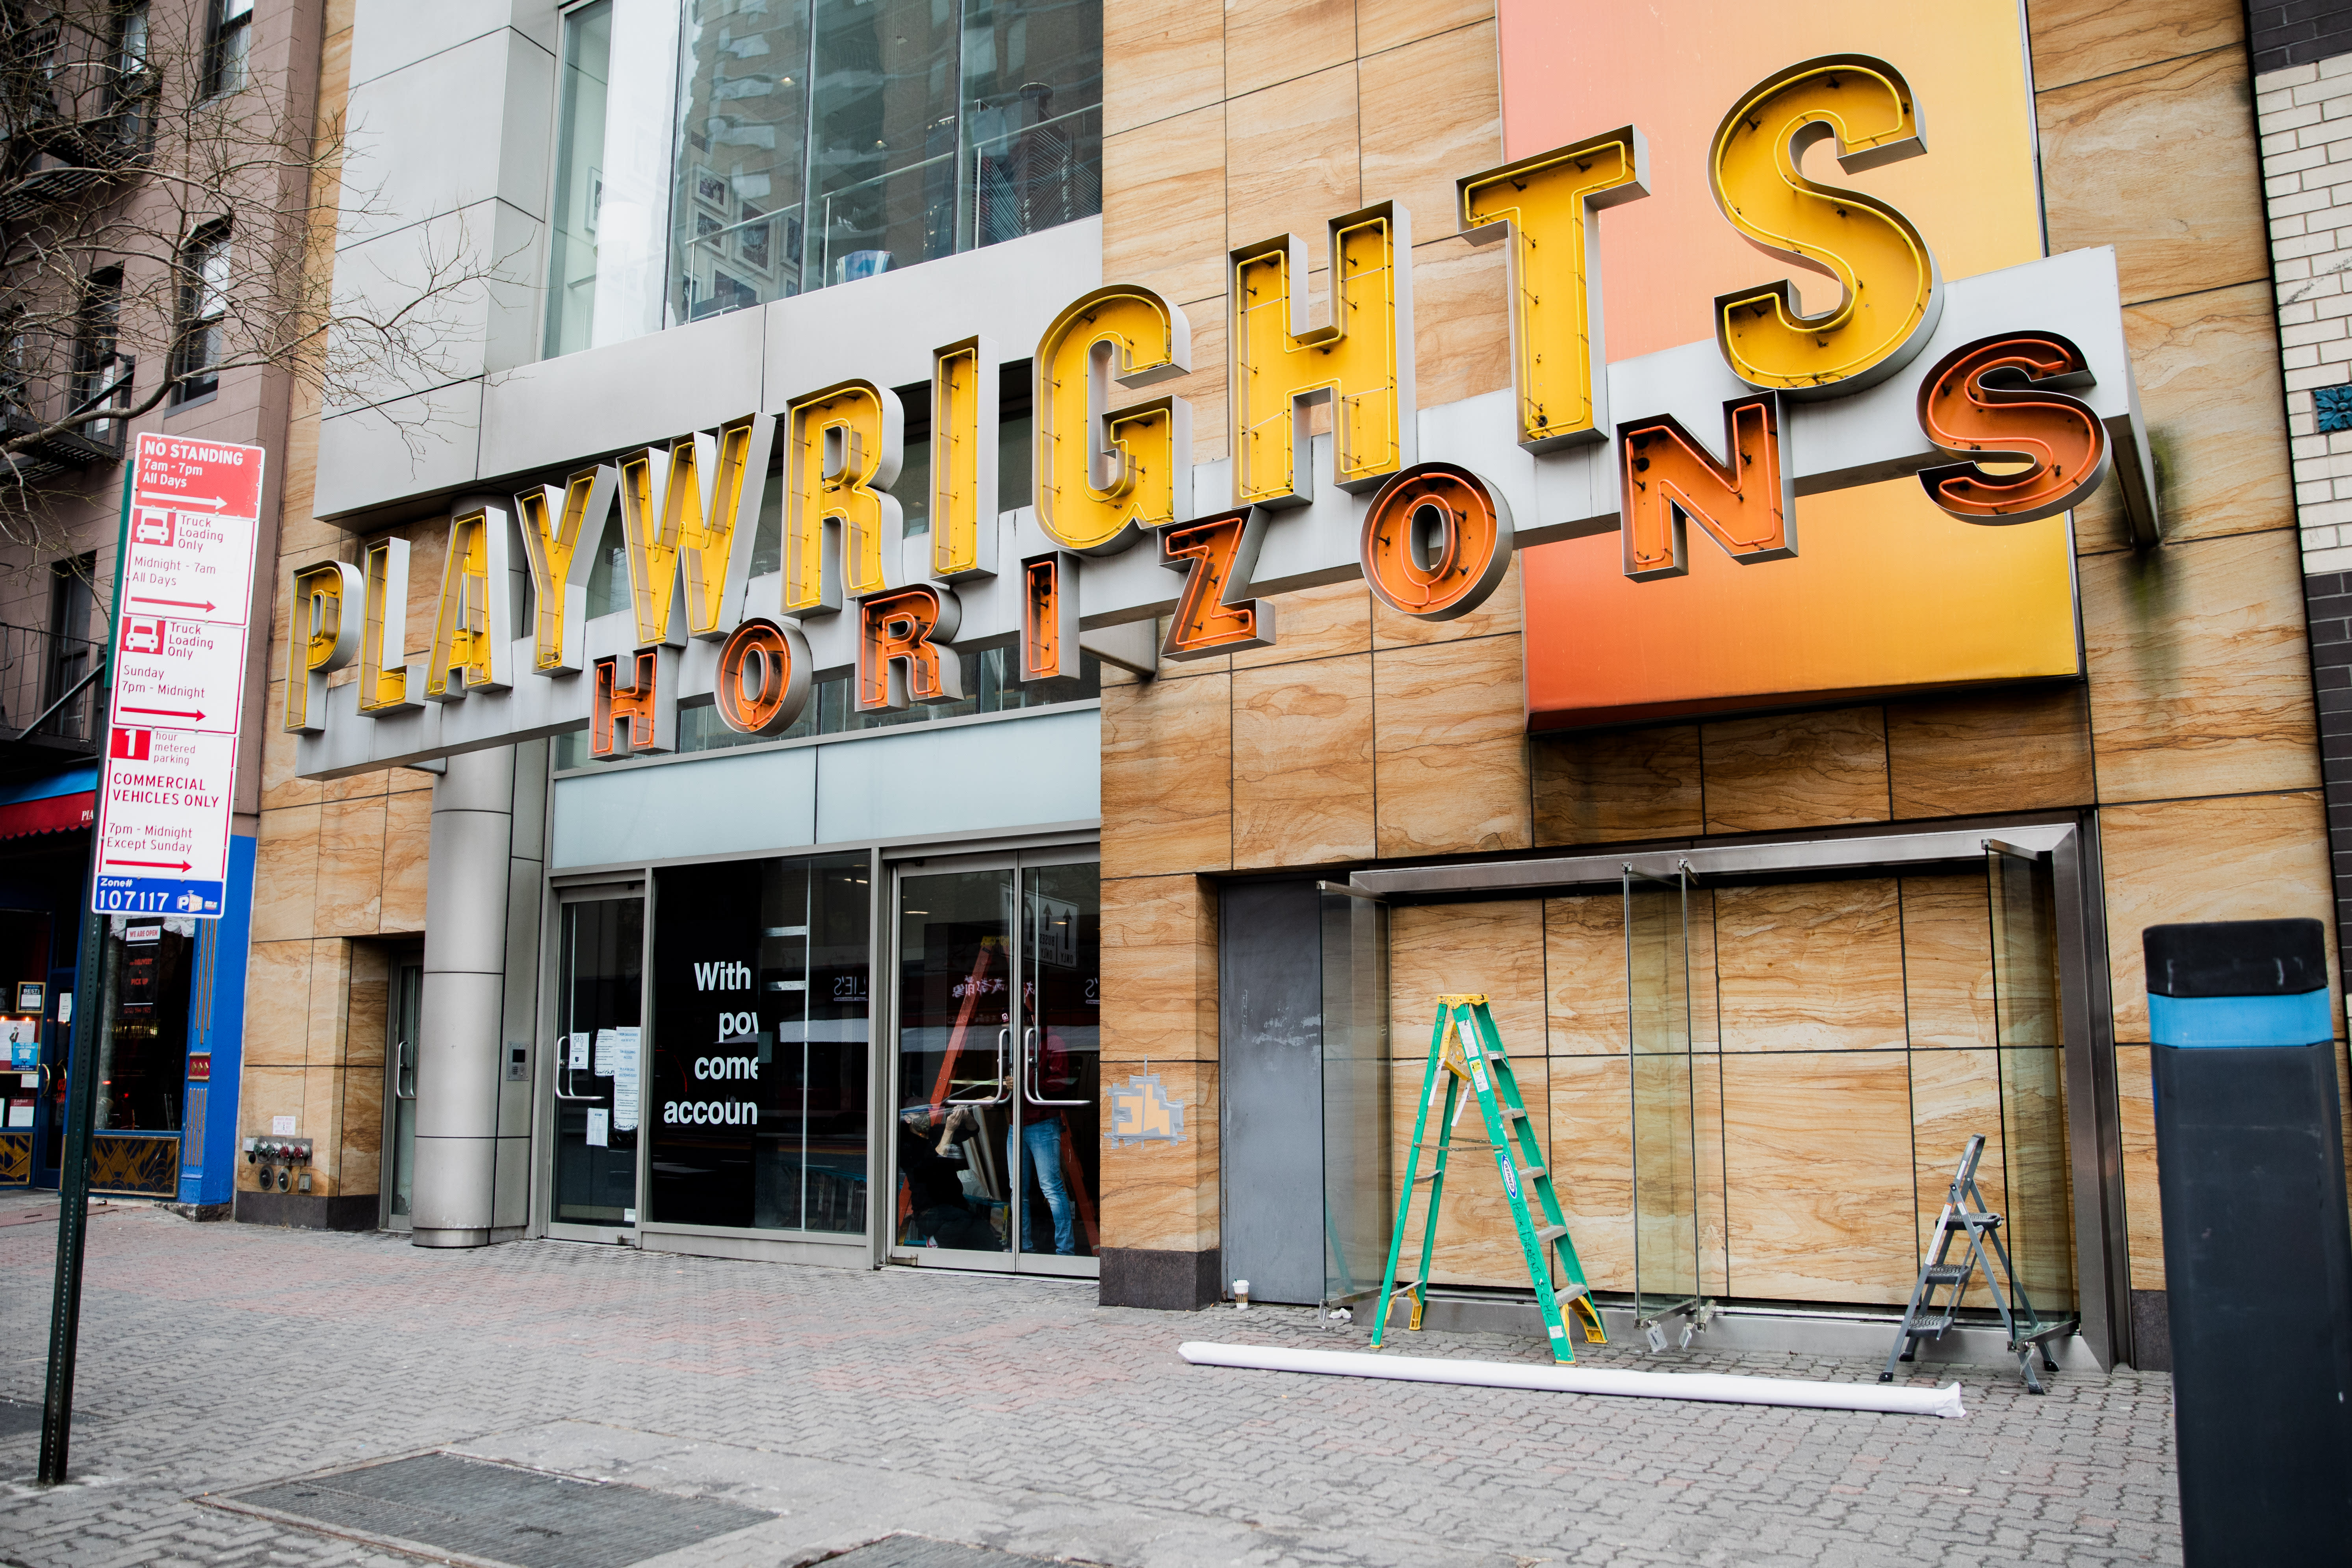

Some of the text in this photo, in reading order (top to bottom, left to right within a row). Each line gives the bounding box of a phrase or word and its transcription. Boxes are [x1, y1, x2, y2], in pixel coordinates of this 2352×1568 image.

[284, 54, 1944, 735] PLAYWRIGHTS
[145, 440, 243, 466] NO STANDING
[144, 458, 168, 472] 7am
[179, 462, 202, 477] 7pm
[143, 472, 187, 489] All Days
[181, 515, 211, 528] Truck
[180, 527, 223, 543] Loading
[178, 539, 203, 552] Only
[588, 330, 2111, 762] HORIZONS
[135, 556, 180, 572] Midnight
[195, 562, 216, 574] 7am
[132, 572, 176, 586] All Days
[171, 622, 201, 635] Truck
[169, 635, 213, 650] Loading
[168, 647, 193, 660] Only
[124, 665, 164, 680] Sunday
[123, 681, 145, 693] 7pm
[158, 685, 205, 700] Midnight
[124, 729, 136, 757] 1
[156, 731, 177, 741] hour
[155, 744, 195, 753] metered
[154, 754, 189, 766] parking
[114, 773, 206, 790] COMMERCIAL
[113, 790, 219, 808] VEHICLES ONLY
[109, 822, 132, 836] 7pm
[145, 826, 193, 839] Midnight
[107, 837, 192, 854] Except Sunday
[101, 878, 133, 887] Zone#
[98, 891, 169, 911] 107117
[694, 961, 750, 991] With
[664, 1101, 757, 1125] accoun
[1504, 1163, 1514, 1190] WERNER
[1520, 1232, 1541, 1274] DIEMONT
